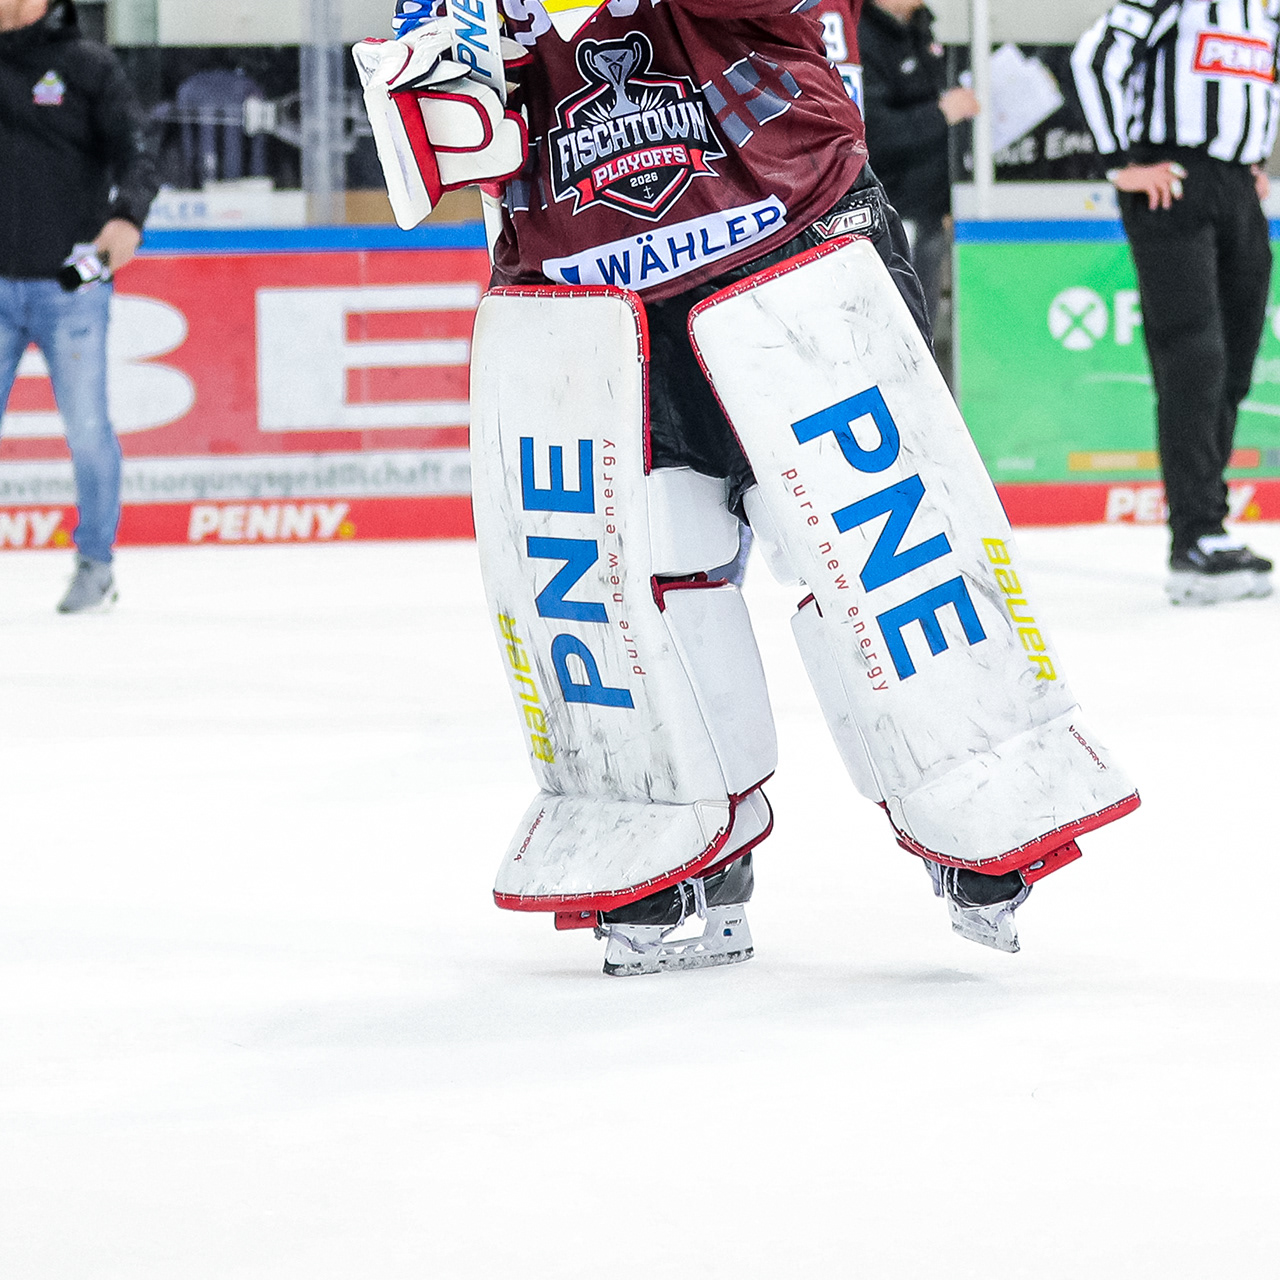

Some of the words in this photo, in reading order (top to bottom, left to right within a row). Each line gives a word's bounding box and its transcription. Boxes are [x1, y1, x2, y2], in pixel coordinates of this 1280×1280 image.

[557, 101, 708, 182] FISCHTOWN
[593, 146, 688, 188] PLAYOFFS
[629, 171, 659, 188] 2026
[602, 438, 616, 534] energy
[520, 437, 635, 710] PNE
[790, 385, 988, 681] PNE
[609, 552, 624, 603] new
[781, 468, 819, 527] pure
[818, 540, 850, 592] new
[847, 605, 889, 692] energy
[619, 620, 646, 676] pure
